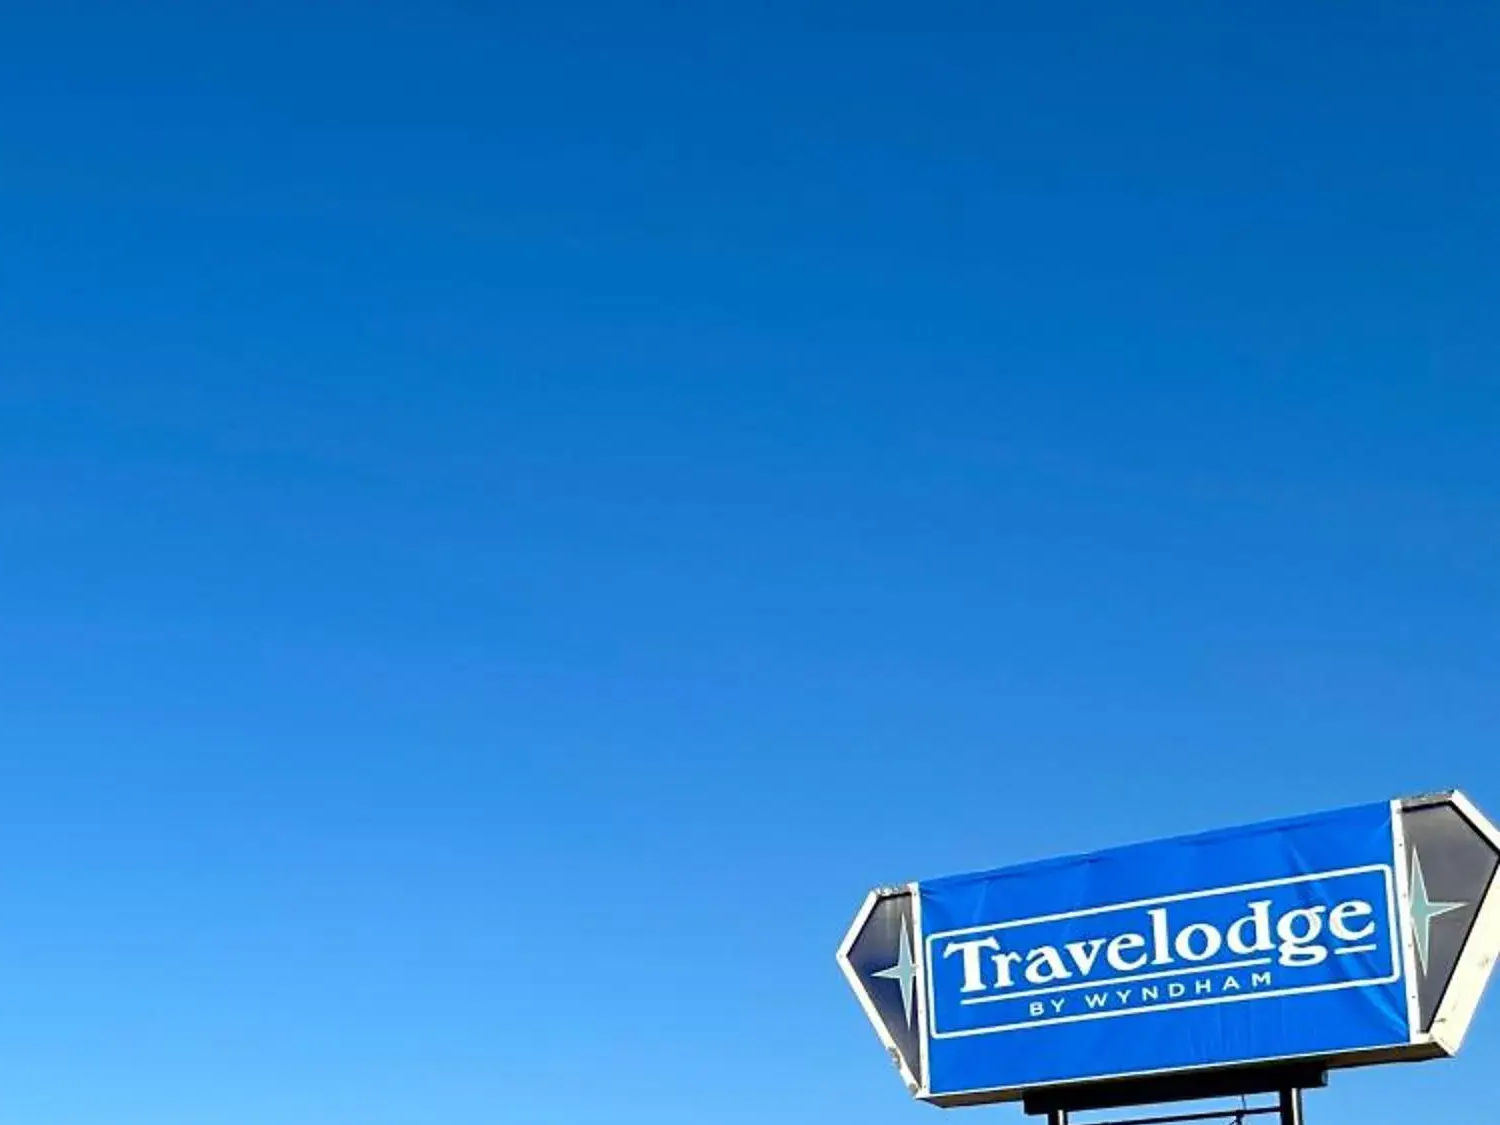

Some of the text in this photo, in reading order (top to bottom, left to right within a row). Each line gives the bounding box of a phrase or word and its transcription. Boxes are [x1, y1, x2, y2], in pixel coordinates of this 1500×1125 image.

[943, 900, 1377, 994] Travelodge
[1030, 971, 1272, 1017] BY WYNDHAM
